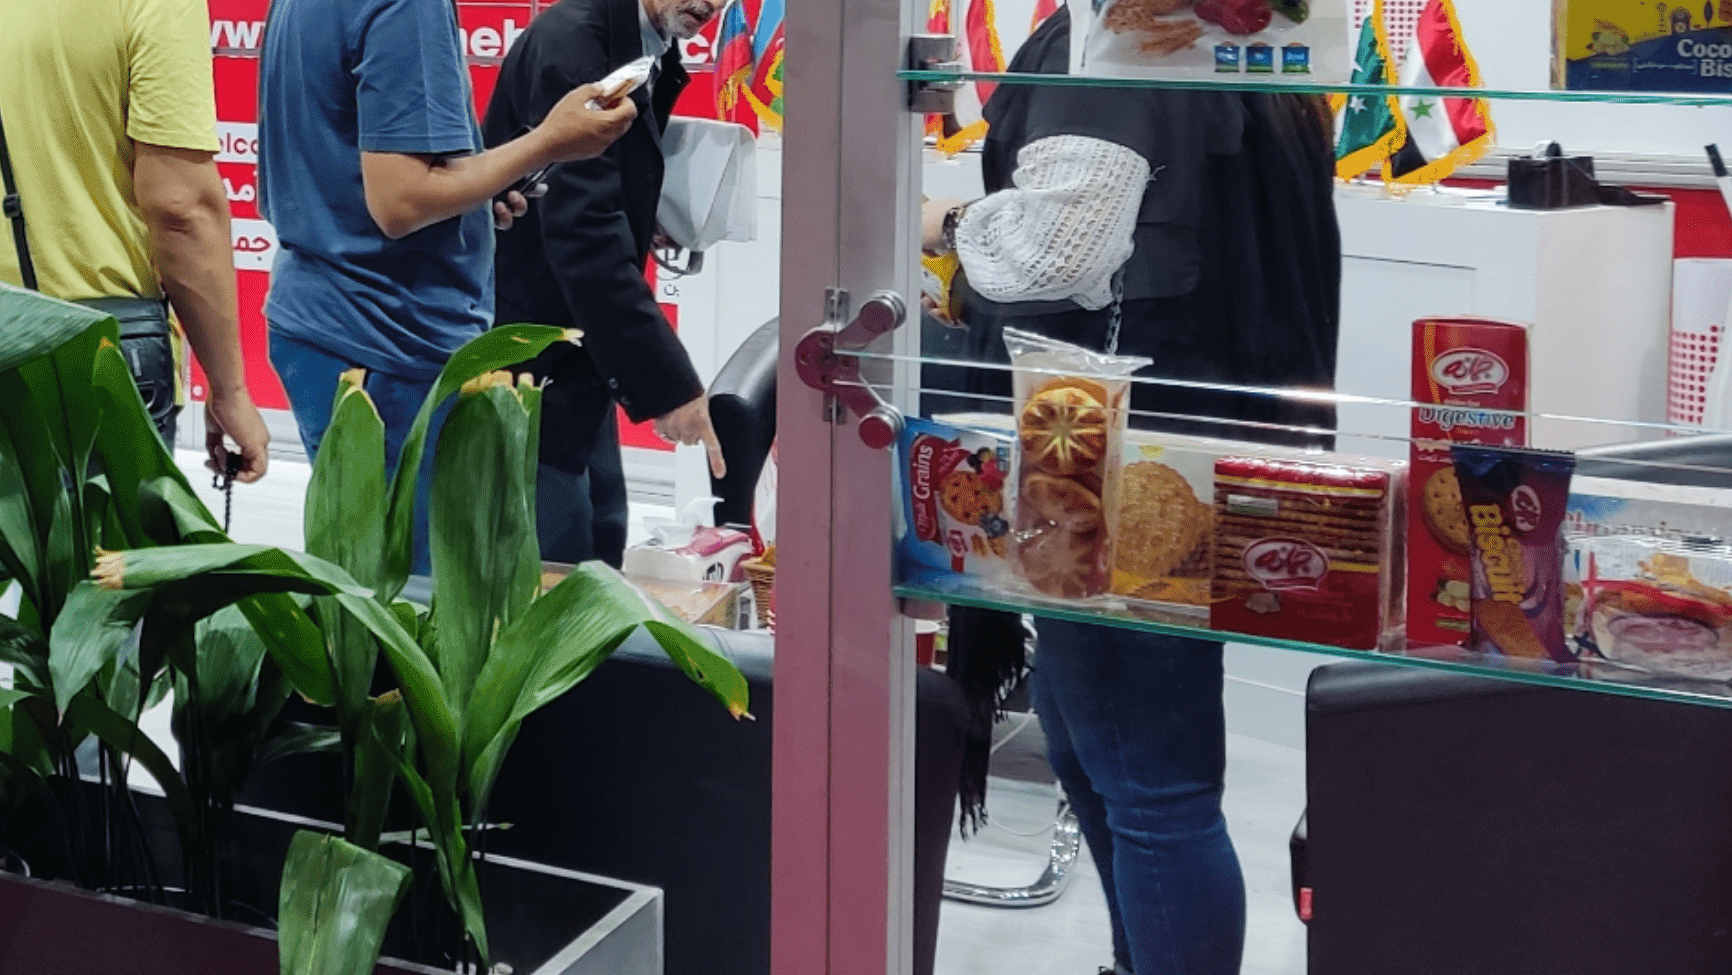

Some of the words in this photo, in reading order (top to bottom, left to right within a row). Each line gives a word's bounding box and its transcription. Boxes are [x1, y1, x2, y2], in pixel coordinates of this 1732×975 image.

[1419, 406, 1516, 431] Digestive
[912, 444, 934, 500] Grains
[1469, 503, 1525, 604] Biscuit
